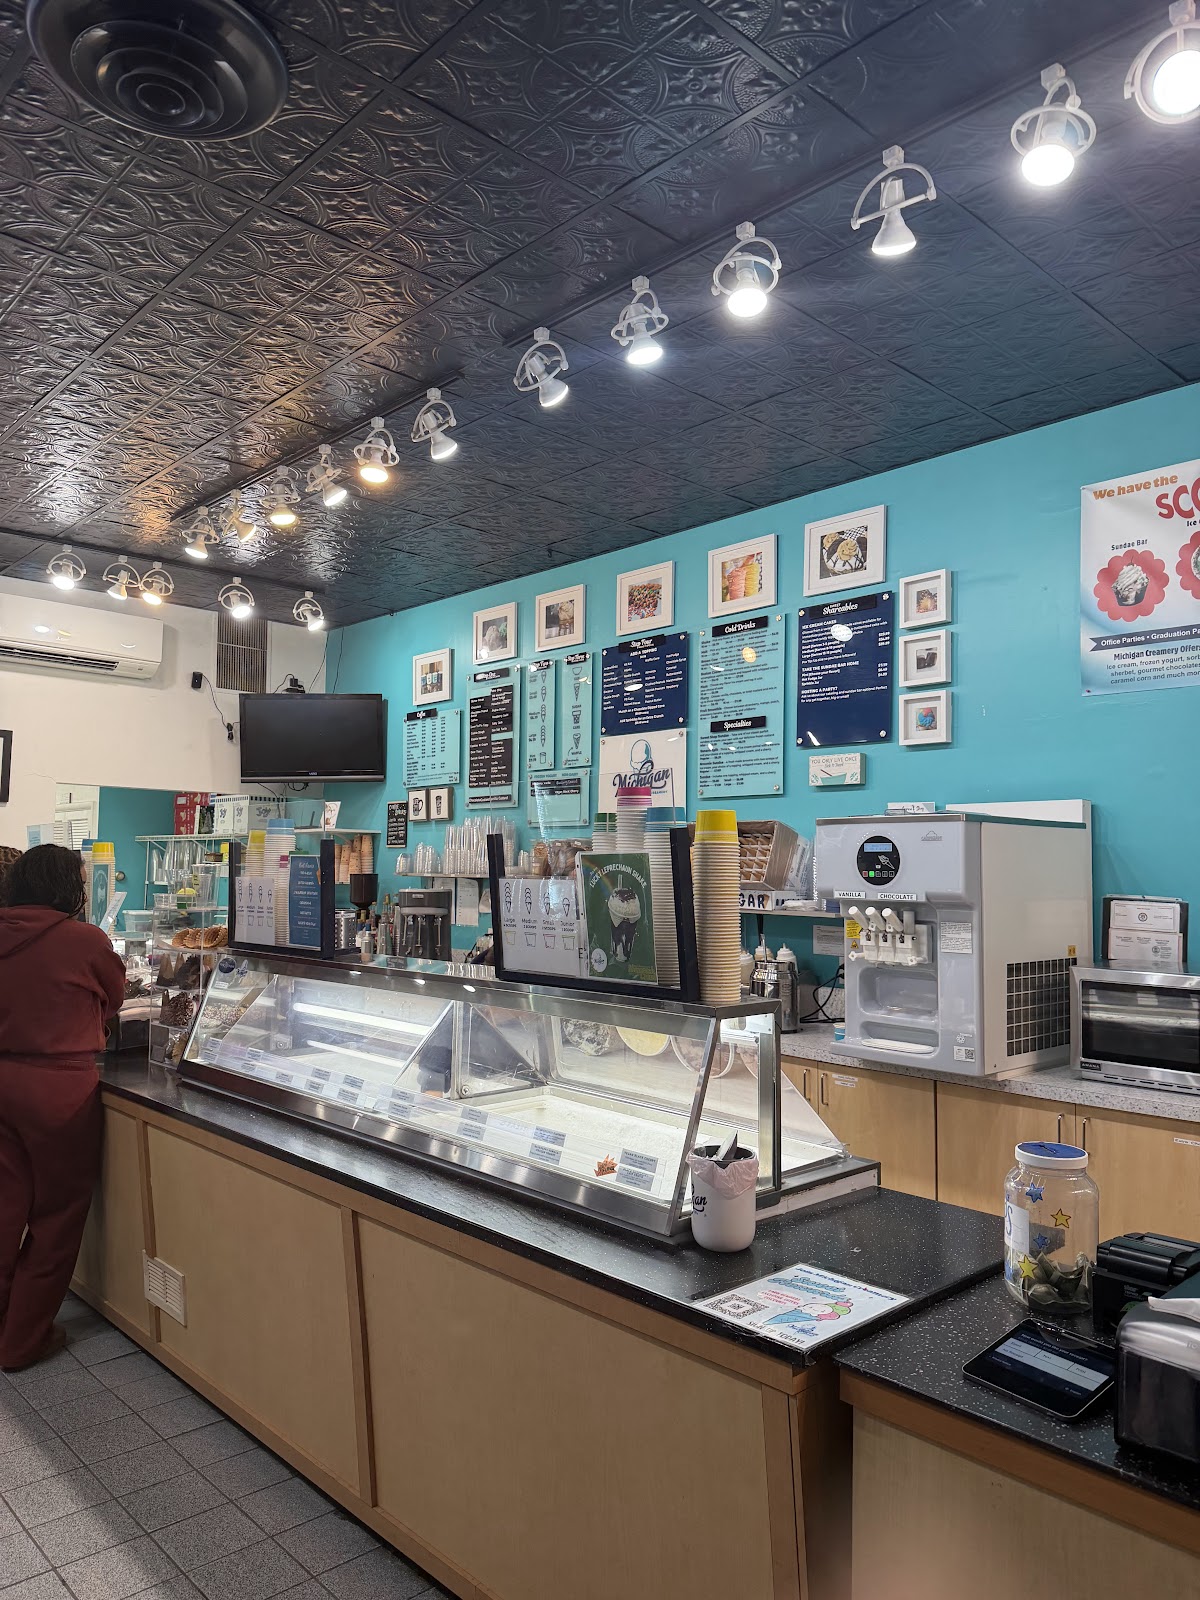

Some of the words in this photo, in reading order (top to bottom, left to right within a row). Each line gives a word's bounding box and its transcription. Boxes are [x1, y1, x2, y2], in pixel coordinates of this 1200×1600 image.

[1093, 489, 1115, 500] We
[1117, 481, 1151, 495] have
[1153, 475, 1178, 487] the
[1111, 541, 1135, 550] Sundae
[823, 602, 858, 615] Shareables
[725, 624, 737, 633] Cold
[738, 621, 756, 631] Drinks
[1151, 629, 1191, 640] Graduation
[1114, 651, 1144, 660] Michigan
[1146, 647, 1178, 657] Creamery
[1162, 656, 1184, 665] yogurt,
[1138, 666, 1165, 674] gourmet
[724, 719, 752, 731] Specialties
[613, 760, 670, 796] Michigan
[590, 870, 602, 888] LUCKY
[601, 864, 632, 874] LEPRECHAUN
[632, 870, 647, 888] SHAKE
